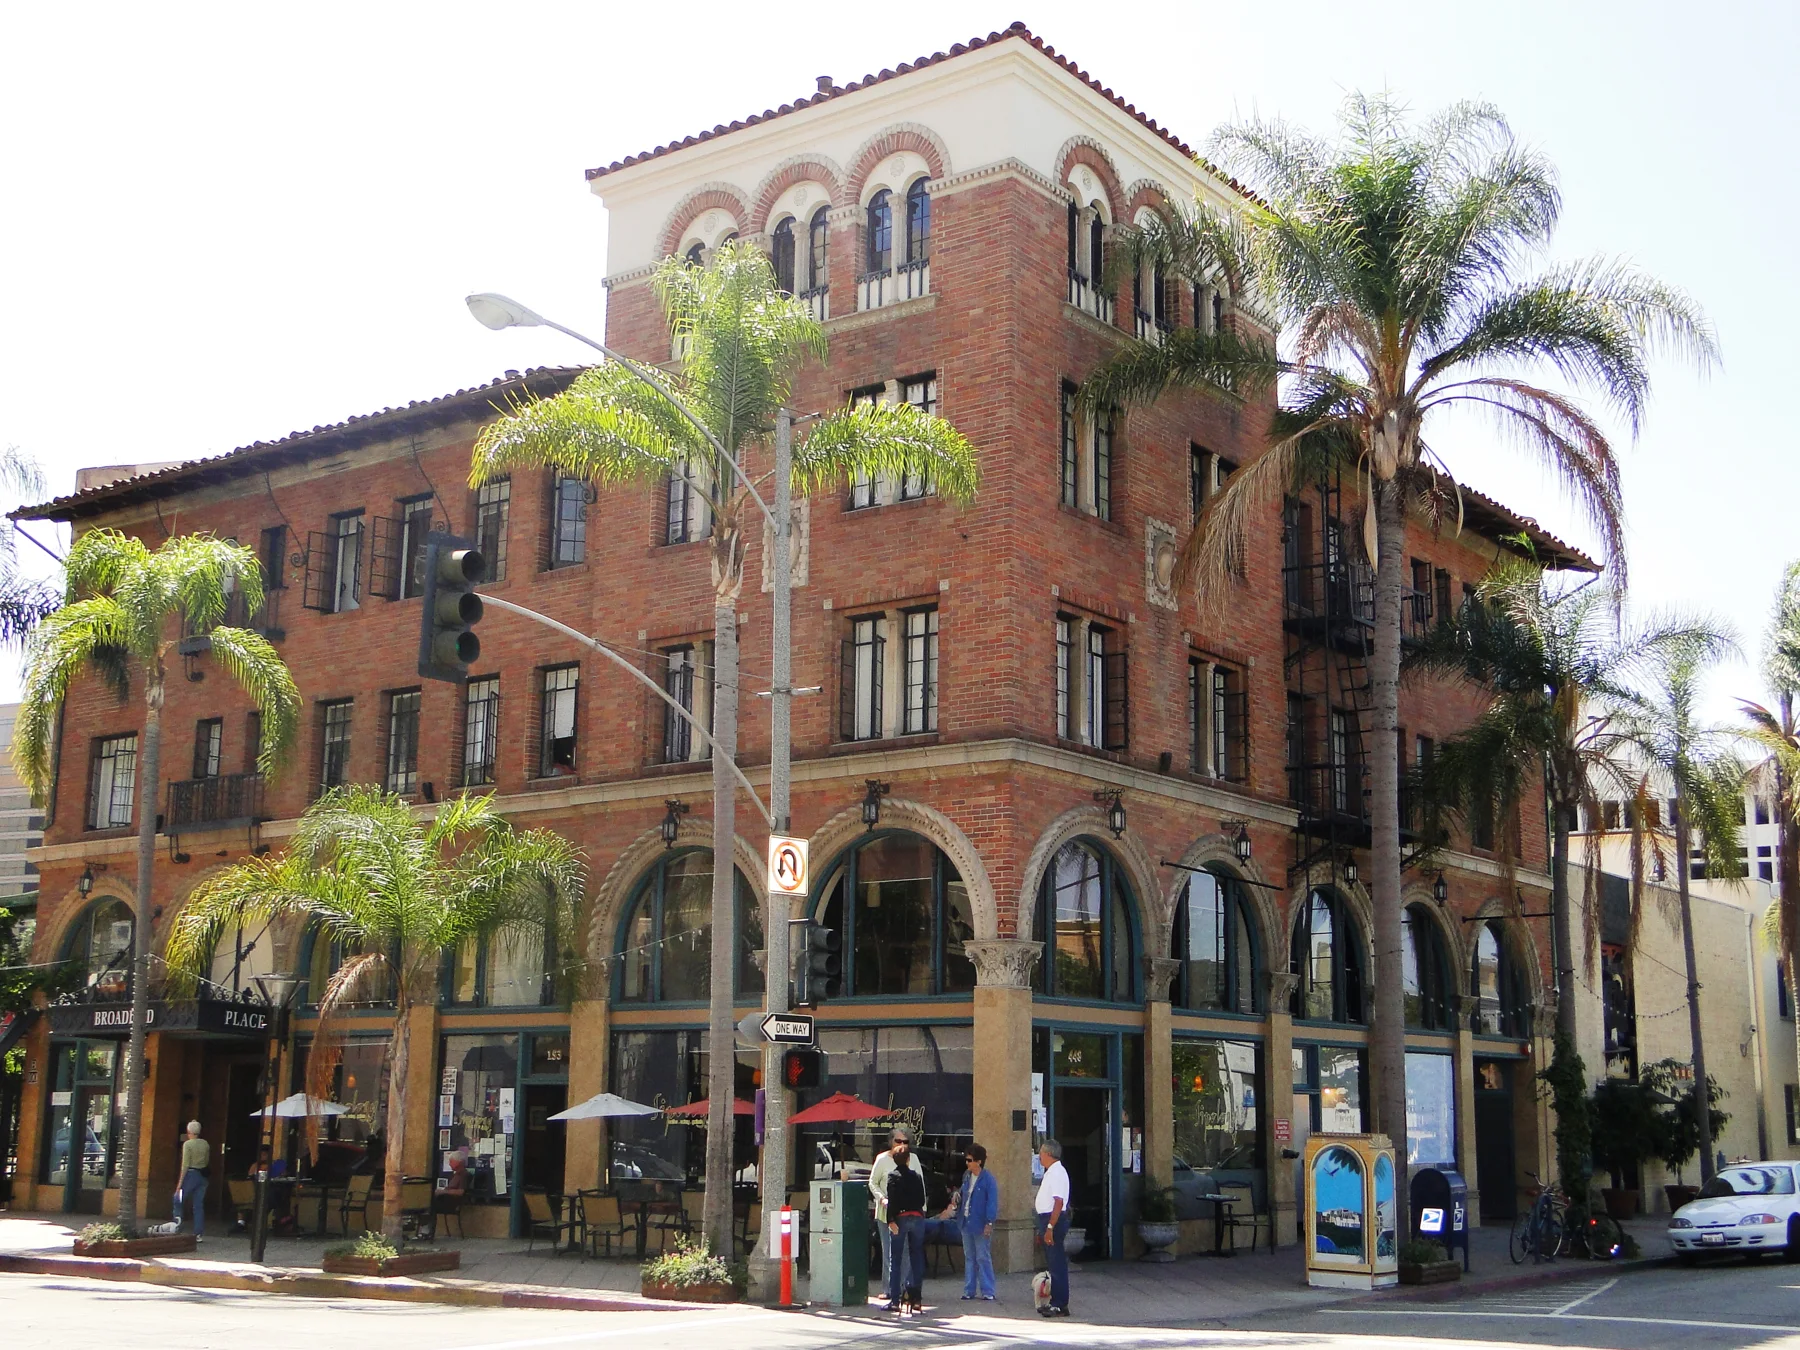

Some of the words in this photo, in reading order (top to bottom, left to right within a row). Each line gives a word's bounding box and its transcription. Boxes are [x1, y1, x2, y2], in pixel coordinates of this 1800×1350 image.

[224, 1010, 266, 1029] PLACE
[776, 1022, 790, 1034] ONE
[792, 1023, 807, 1035] WAY
